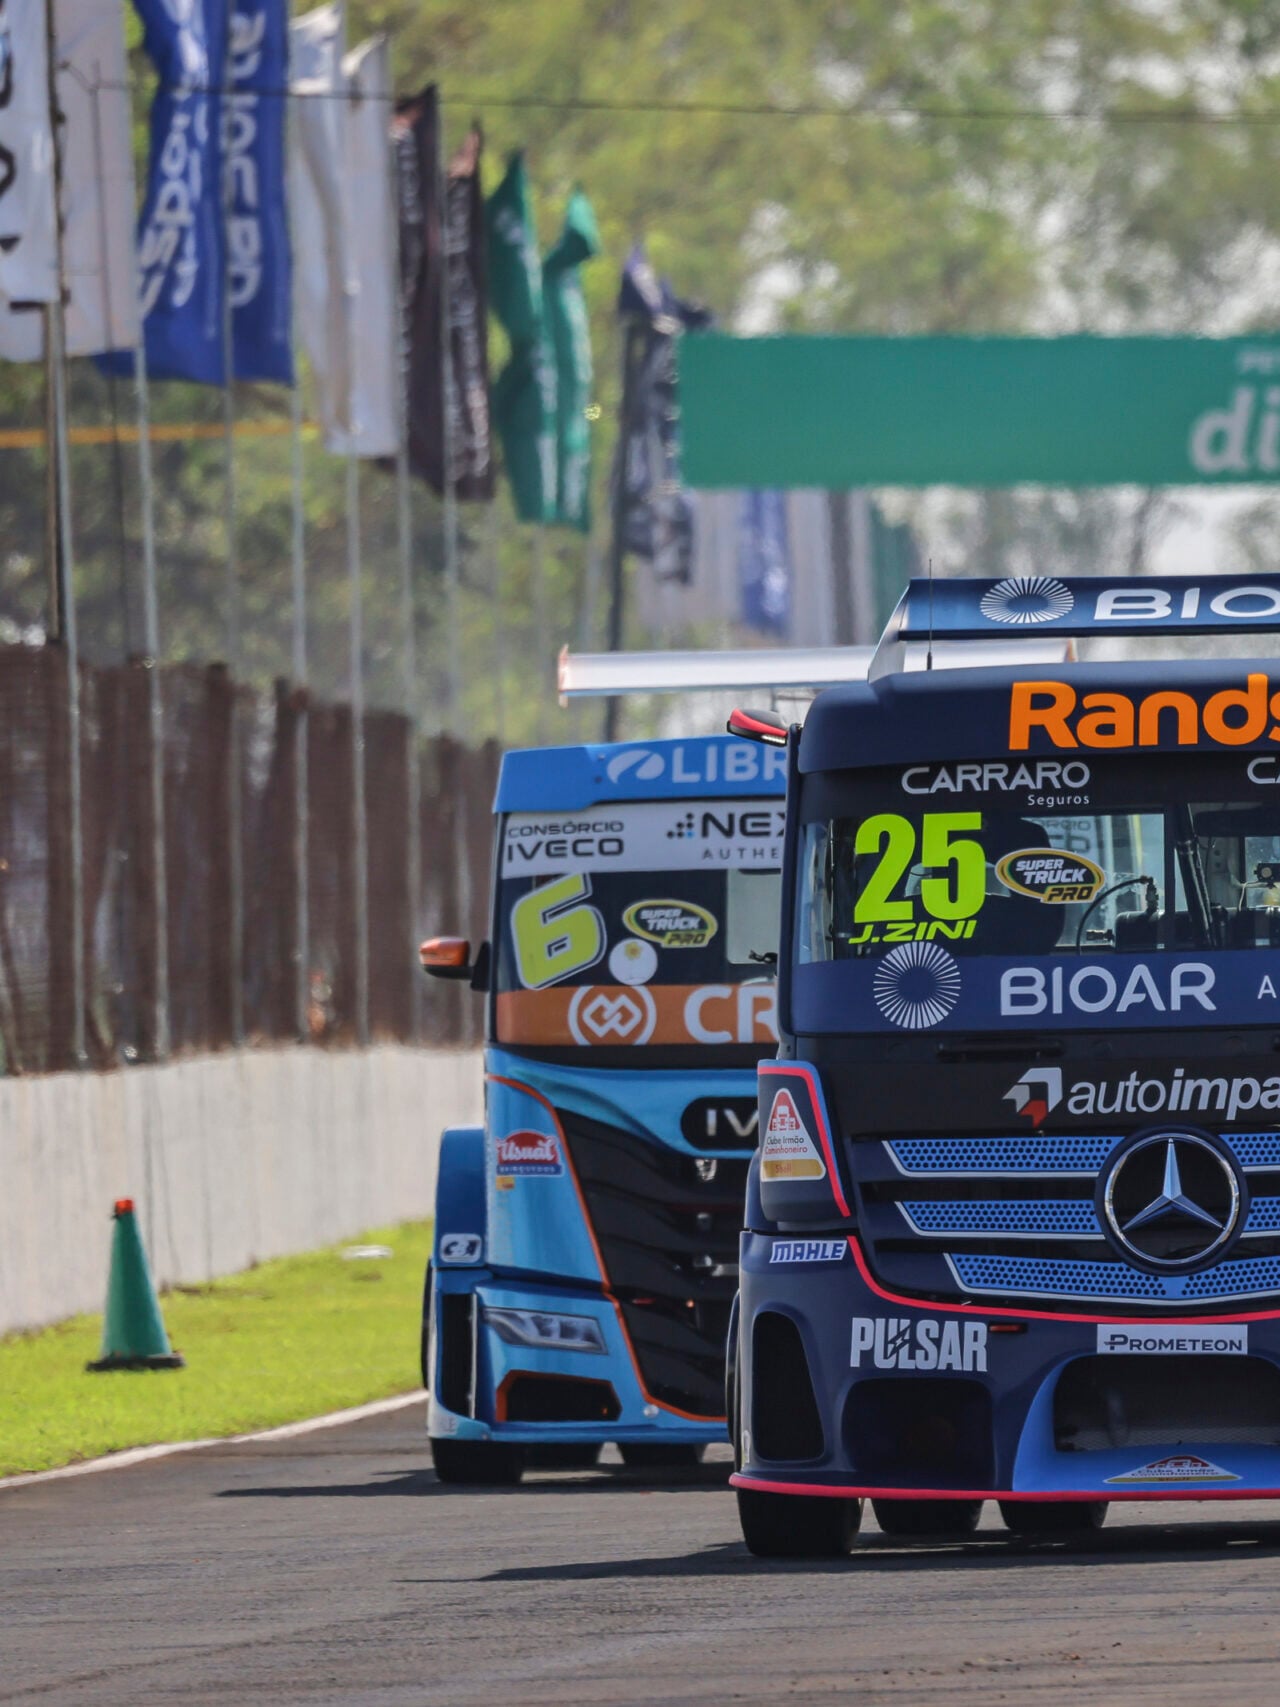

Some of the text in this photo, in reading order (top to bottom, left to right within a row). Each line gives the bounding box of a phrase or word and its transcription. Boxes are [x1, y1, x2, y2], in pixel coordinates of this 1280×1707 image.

[902, 760, 1091, 794] CARRARO
[1027, 793, 1091, 808] Seguros
[507, 820, 625, 839] CONSÓRCIO
[507, 837, 625, 862] IVECO
[853, 811, 986, 922] 25
[1016, 858, 1065, 872] SUPER
[1023, 868, 1088, 885] TRUCK
[1046, 885, 1094, 901] PRO
[640, 907, 684, 921] SUPER
[646, 915, 702, 931] TRUCK
[510, 872, 607, 991] 6
[667, 932, 707, 945] PRO
[848, 919, 978, 944] J.ZINI
[1000, 962, 1217, 1016] BIOAR
[766, 1135, 805, 1146] Clube Irmão
[775, 1164, 792, 1174] Shell
[772, 1241, 846, 1262] MAHLE
[849, 1315, 989, 1372] PULSAR
[1102, 1331, 1245, 1354] PROMETEON
